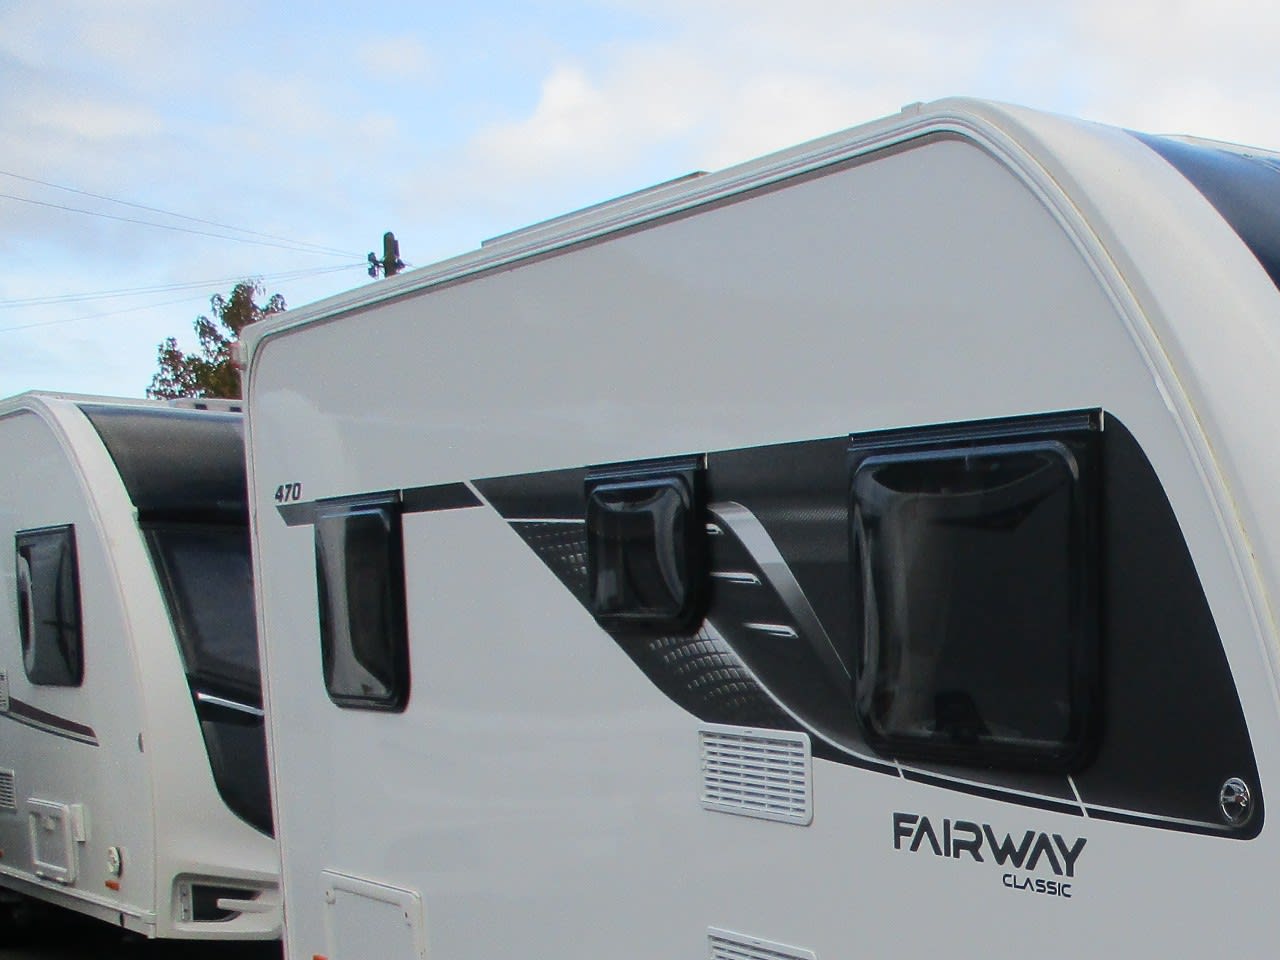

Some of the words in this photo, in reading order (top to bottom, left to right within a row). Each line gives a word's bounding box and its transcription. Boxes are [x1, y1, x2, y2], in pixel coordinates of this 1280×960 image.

[275, 482, 301, 502] 470
[893, 812, 1087, 877] FAIRWAY
[1002, 873, 1072, 898] CLASSIC
